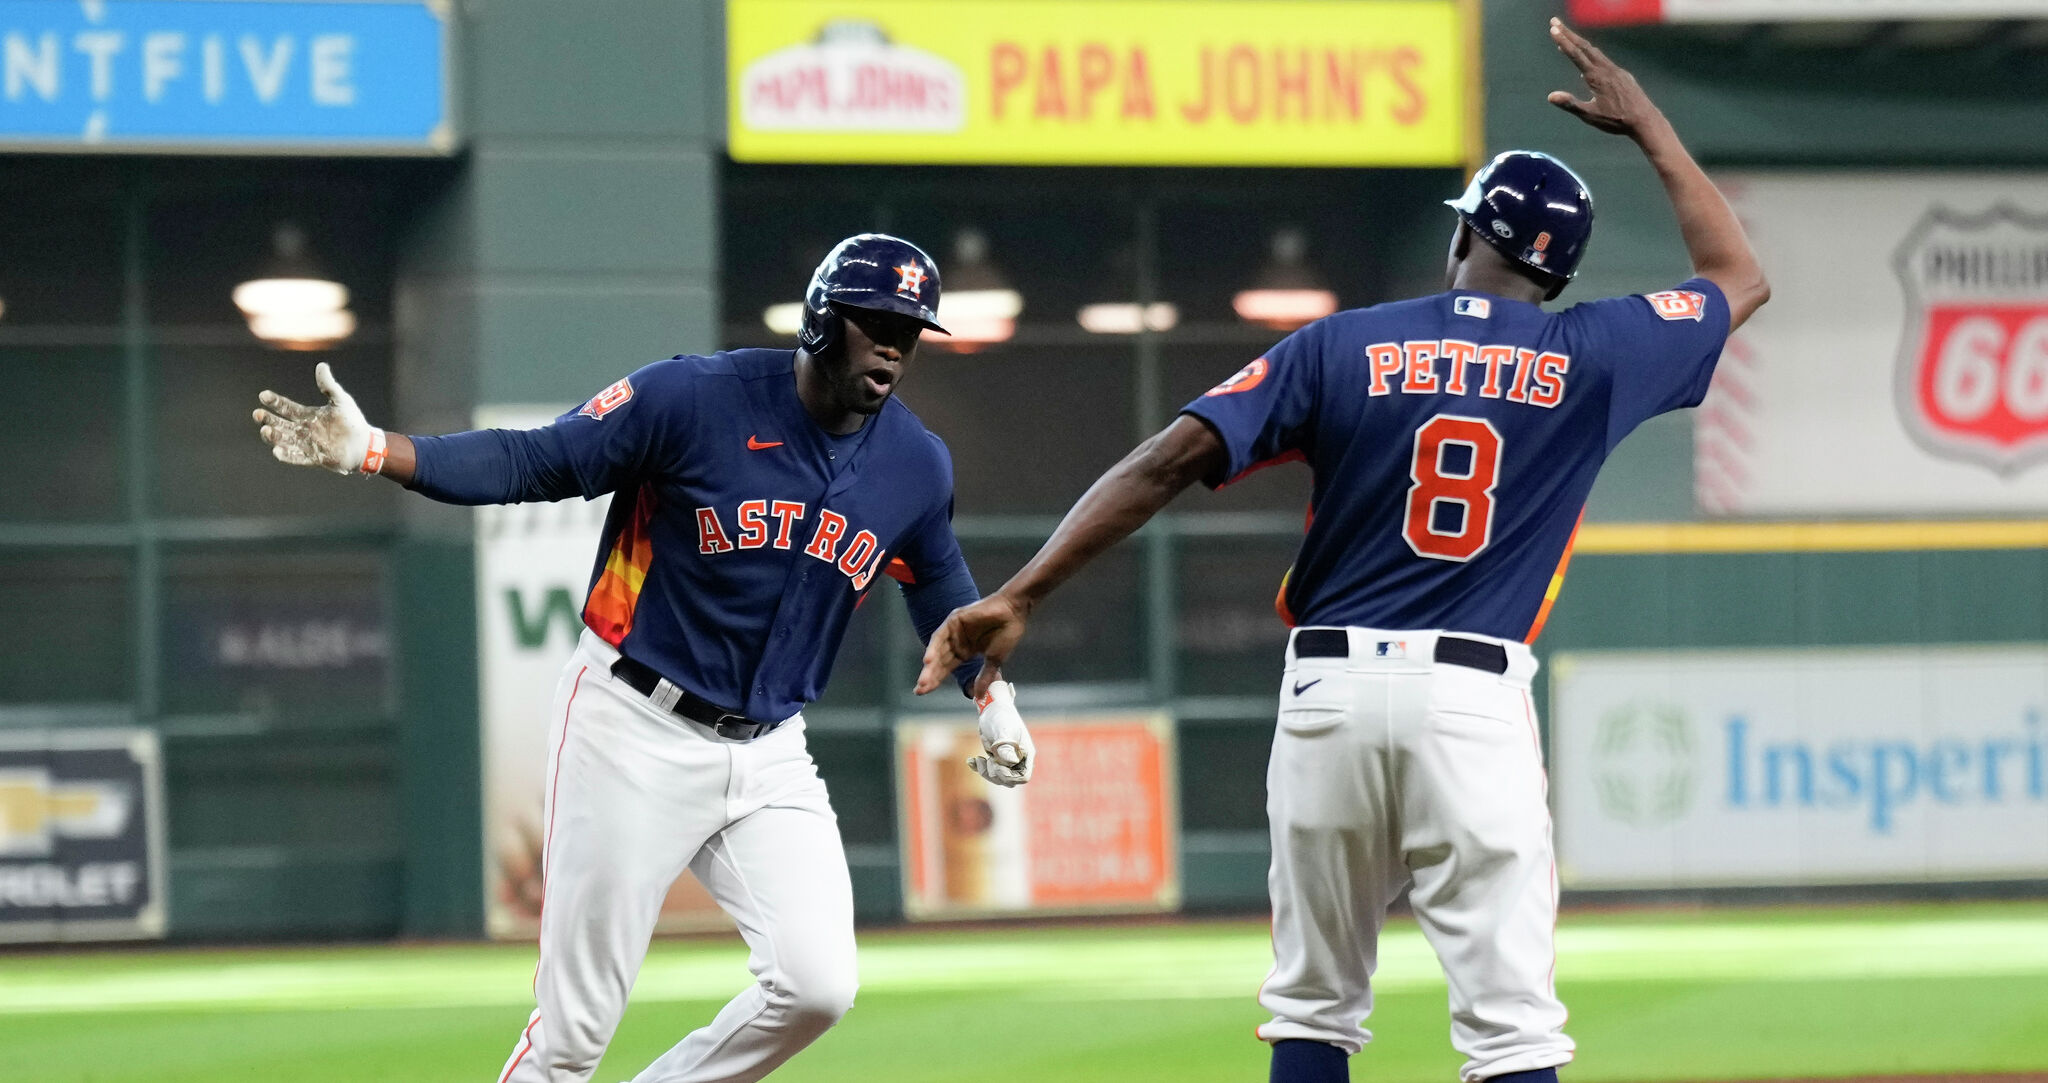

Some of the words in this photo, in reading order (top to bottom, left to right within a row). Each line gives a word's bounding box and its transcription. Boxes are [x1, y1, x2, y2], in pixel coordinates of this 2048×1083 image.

[990, 43, 1156, 124] PAPA
[1182, 44, 1428, 126] JOHN'S
[1534, 232, 1551, 252] 8
[1366, 339, 1570, 408] PETTIS
[1933, 315, 2048, 423] 66
[1402, 413, 1504, 563] 8
